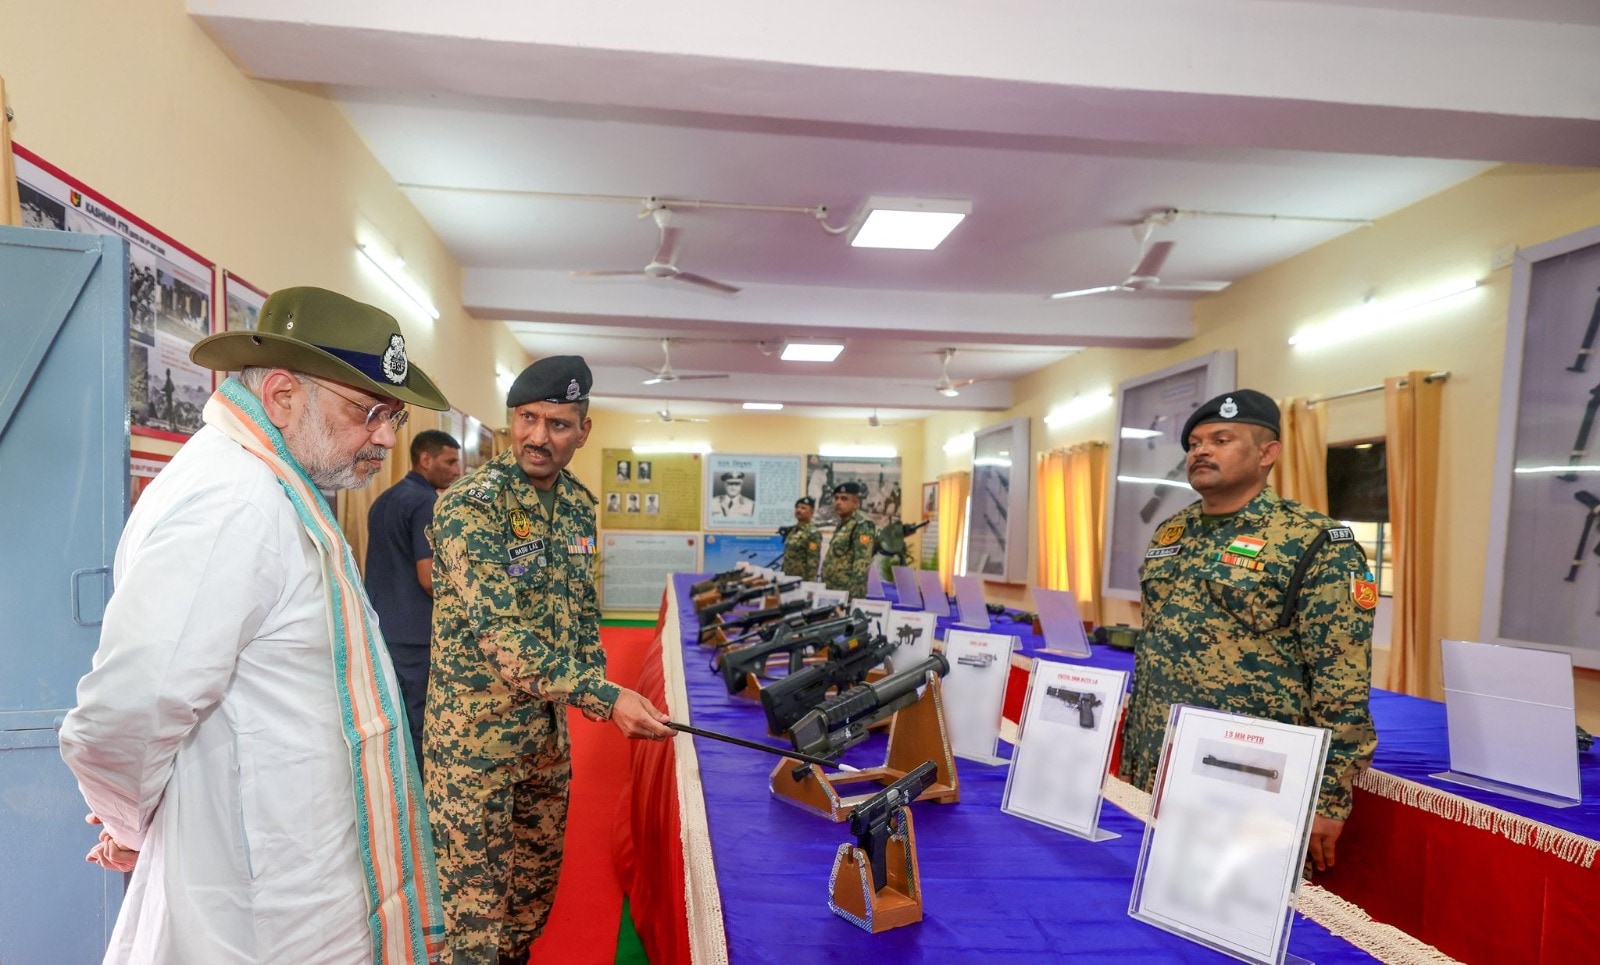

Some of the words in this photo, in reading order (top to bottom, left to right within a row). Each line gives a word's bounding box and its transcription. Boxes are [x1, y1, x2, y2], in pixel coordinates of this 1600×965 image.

[85, 202, 116, 227] KASHMIR
[468, 489, 490, 501] BSF
[514, 546, 528, 556] BABU
[1234, 731, 1246, 740] MM
